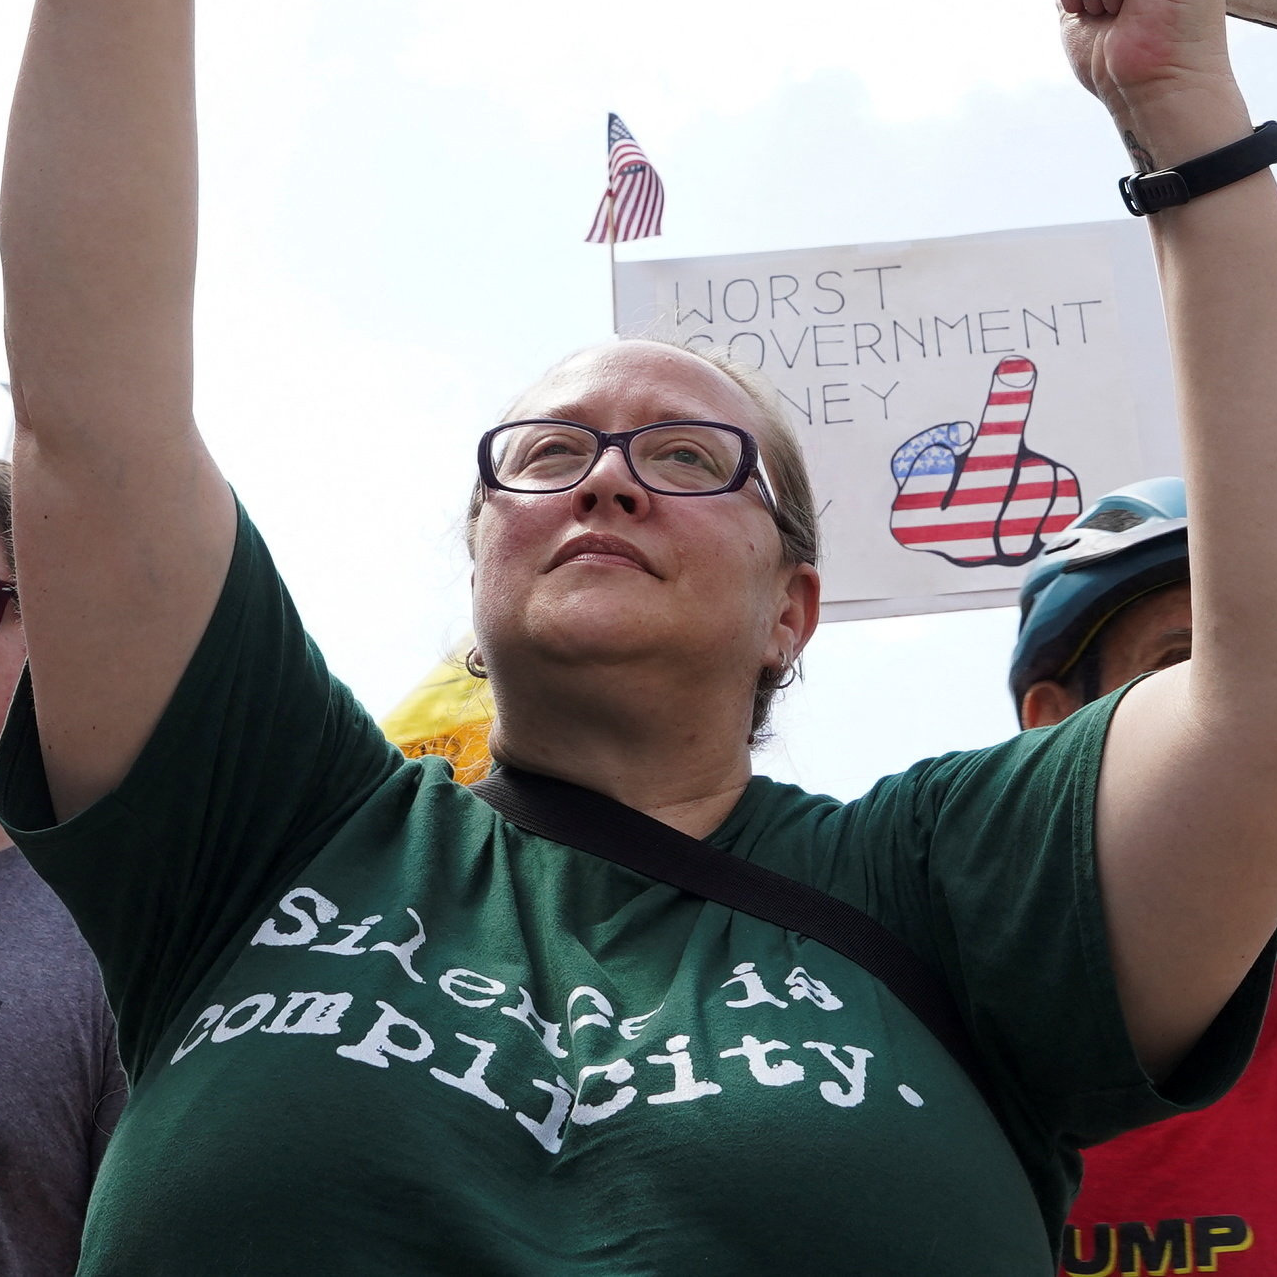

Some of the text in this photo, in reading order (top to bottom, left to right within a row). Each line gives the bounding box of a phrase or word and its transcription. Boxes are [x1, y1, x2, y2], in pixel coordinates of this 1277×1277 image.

[674, 265, 902, 327] WORST
[251, 887, 844, 1059] Silence is
[170, 989, 925, 1155] complicity.
[1060, 1214, 1254, 1277] UMP
